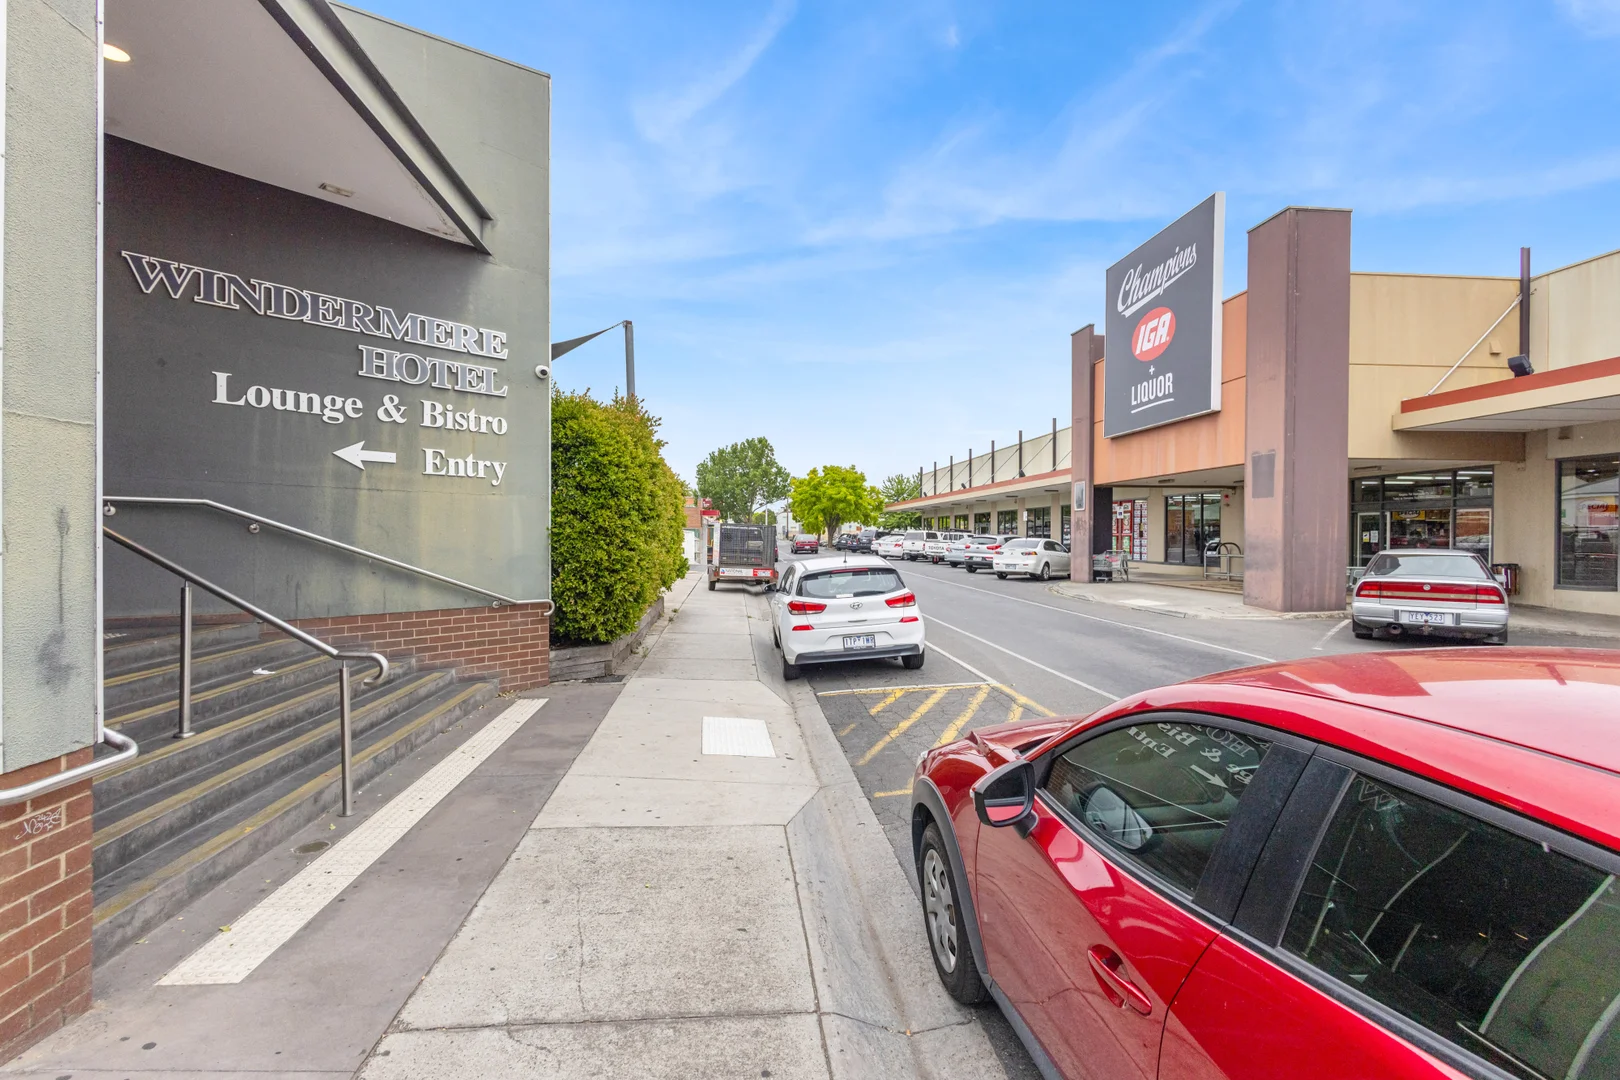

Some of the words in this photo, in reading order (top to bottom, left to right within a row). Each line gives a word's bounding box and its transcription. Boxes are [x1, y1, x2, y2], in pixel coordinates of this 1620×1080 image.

[120, 250, 509, 360] WINDERMERE
[1117, 242, 1197, 315] Champions
[1135, 311, 1171, 355] IGA
[358, 344, 509, 397] HOTEL
[1131, 372, 1174, 406] LIQUOR
[211, 371, 363, 424] Lounge
[376, 394, 407, 424] &
[420, 400, 508, 436] Bistro
[422, 447, 508, 486] Entry
